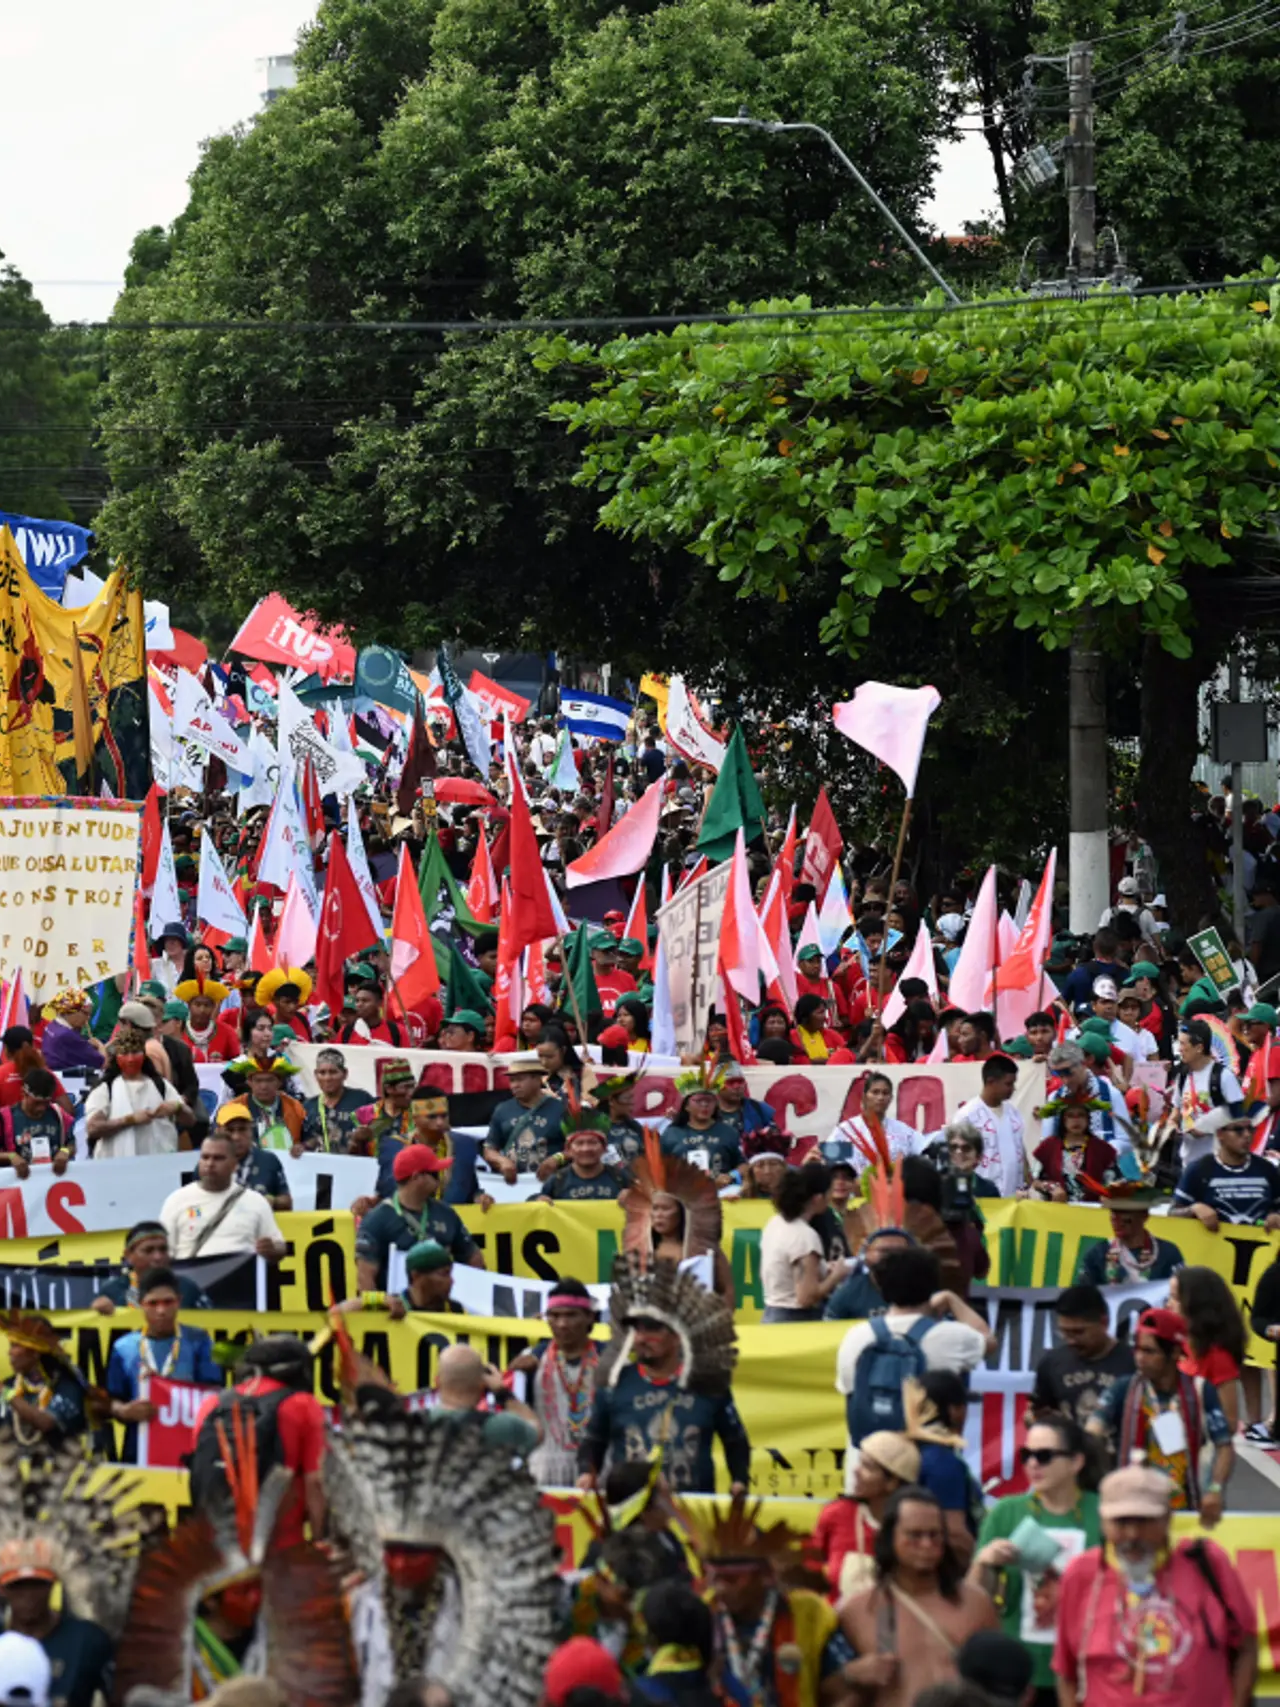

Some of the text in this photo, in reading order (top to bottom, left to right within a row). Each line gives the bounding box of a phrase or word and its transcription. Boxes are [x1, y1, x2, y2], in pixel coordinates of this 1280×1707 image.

[25, 854, 67, 873] OUSA
[70, 855, 136, 874] LUTAR
[41, 917, 54, 931] O
[2, 934, 105, 958] PODER
[0, 957, 111, 989] PULAR
[570, 1186, 594, 1198] COP
[1062, 1369, 1095, 1388] COP
[633, 1390, 670, 1410] COP
